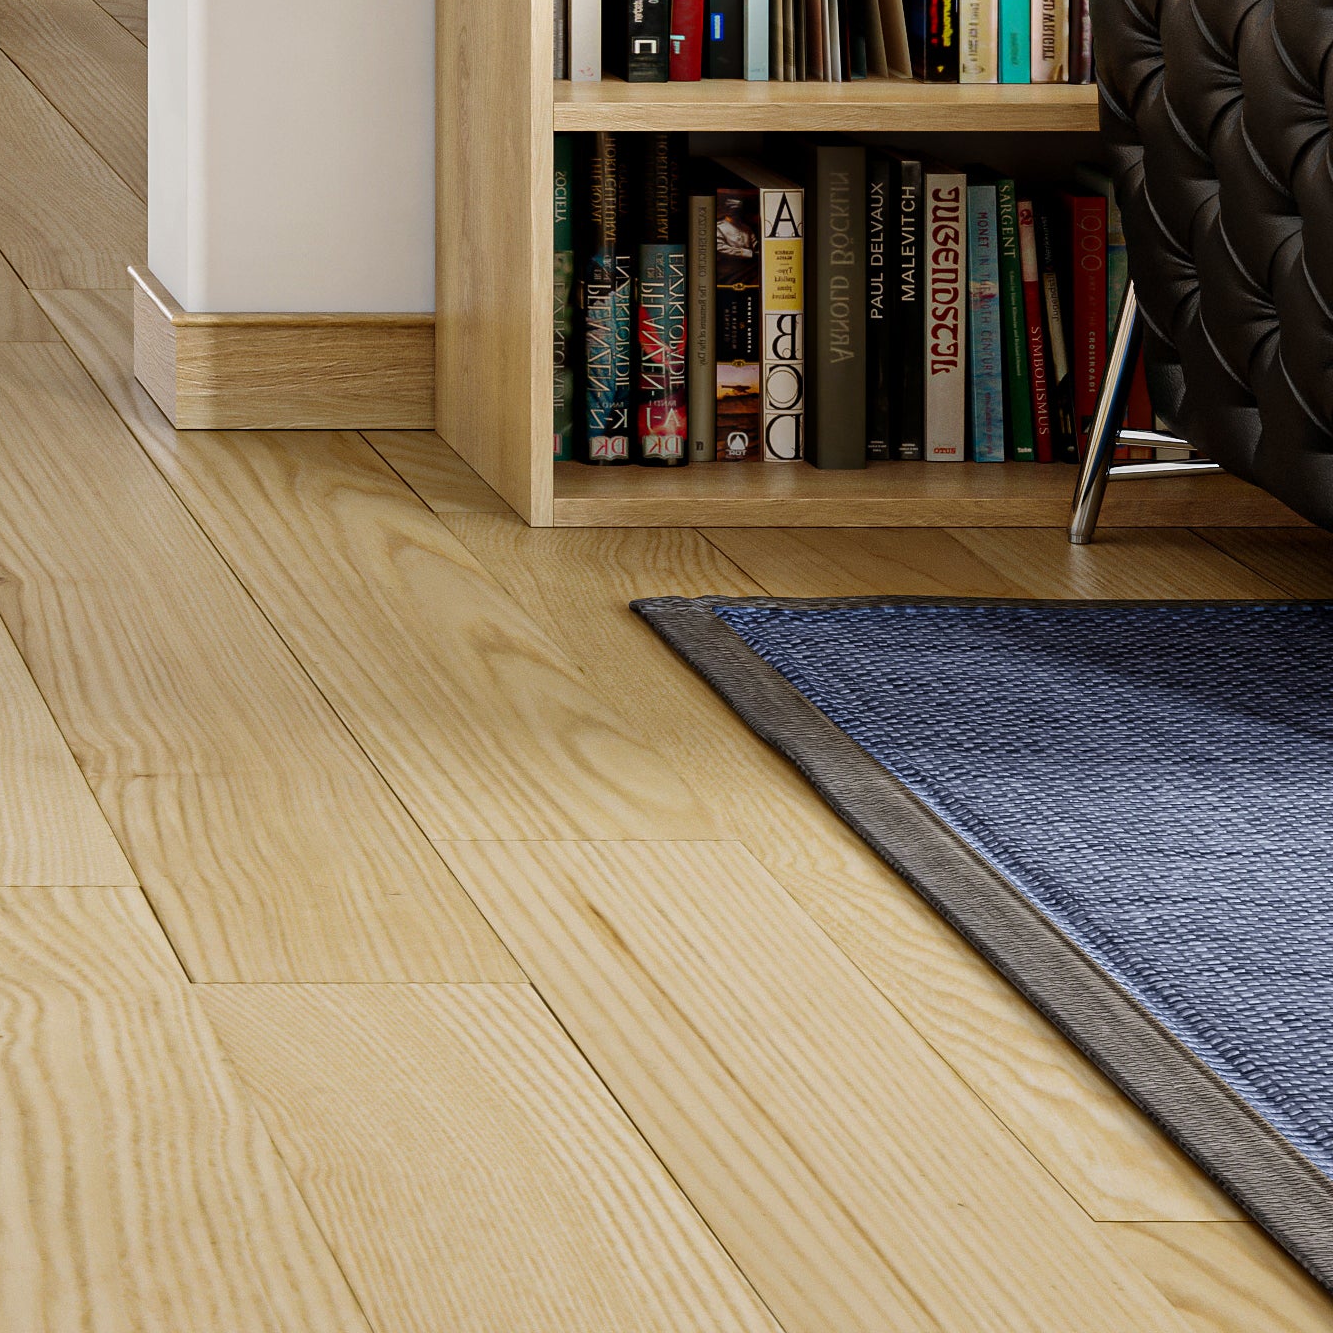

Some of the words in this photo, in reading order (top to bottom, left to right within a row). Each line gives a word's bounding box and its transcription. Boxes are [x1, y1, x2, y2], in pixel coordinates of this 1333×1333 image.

[869, 181, 884, 267] DELVAUX
[901, 185, 916, 302] MALEVITCH
[976, 211, 990, 249] MONET
[998, 184, 1016, 260] SARGENT
[1082, 207, 1102, 272] 1900
[978, 255, 990, 269] IN
[869, 268, 884, 320] PAUL
[979, 329, 993, 378] CENTURY
[1030, 325, 1049, 436] SYMBOLISMUS
[933, 446, 957, 455] OTUS
